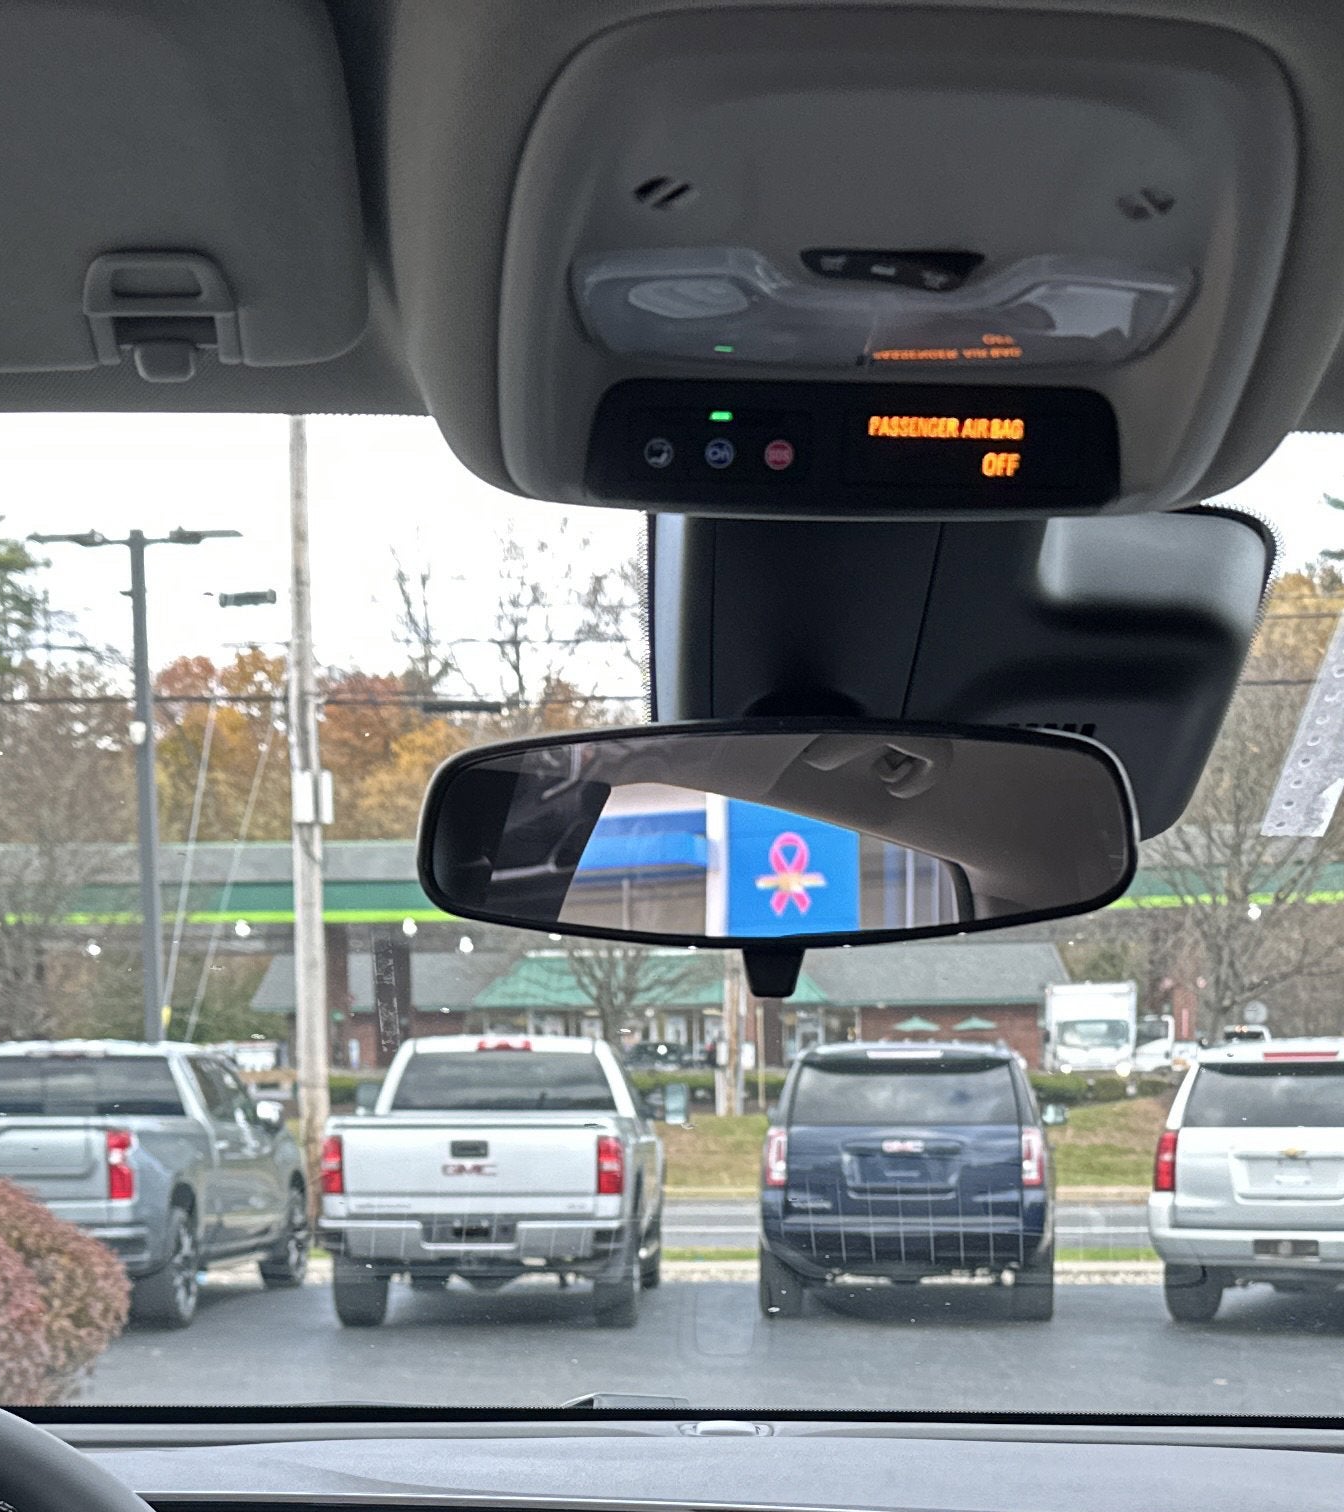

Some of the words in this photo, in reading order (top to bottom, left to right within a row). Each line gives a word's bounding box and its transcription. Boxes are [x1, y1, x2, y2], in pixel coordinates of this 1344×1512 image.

[868, 416, 960, 438] PASSENGER
[961, 418, 989, 439] AIR
[990, 418, 1024, 440] BAG
[981, 452, 1021, 477] OFF
[442, 1164, 497, 1176] GMC
